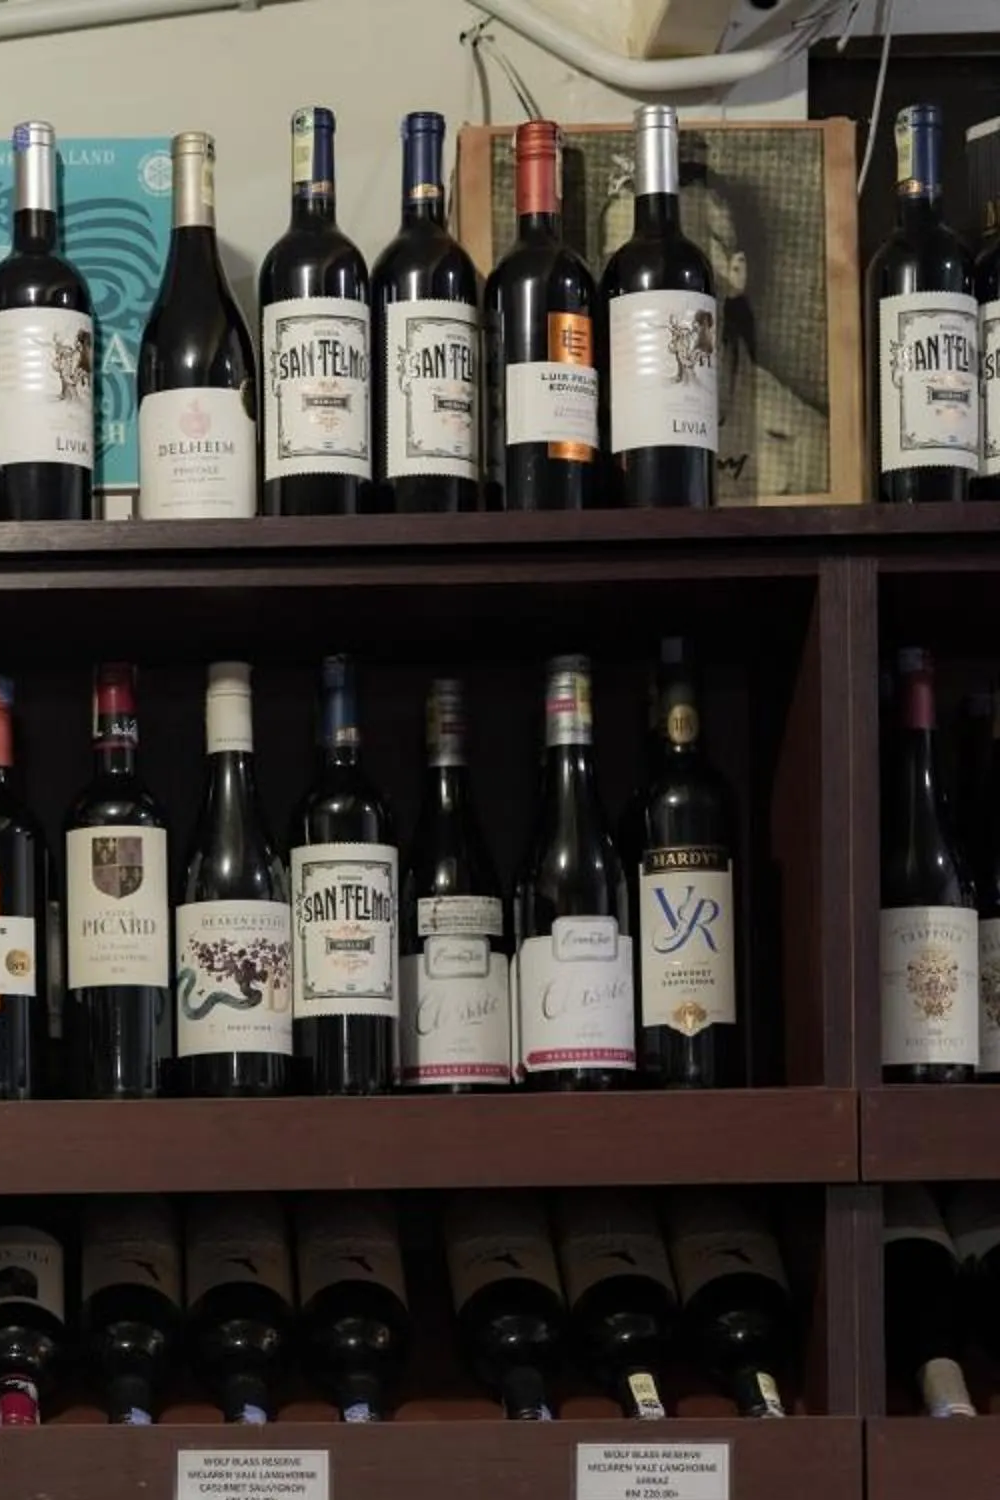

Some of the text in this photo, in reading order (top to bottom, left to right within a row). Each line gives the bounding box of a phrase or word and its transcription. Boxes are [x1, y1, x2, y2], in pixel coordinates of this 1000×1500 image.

[279, 340, 315, 380] SAN
[304, 884, 337, 922] SAN
[340, 883, 391, 923] TELMO
[82, 918, 156, 937] PICARD
